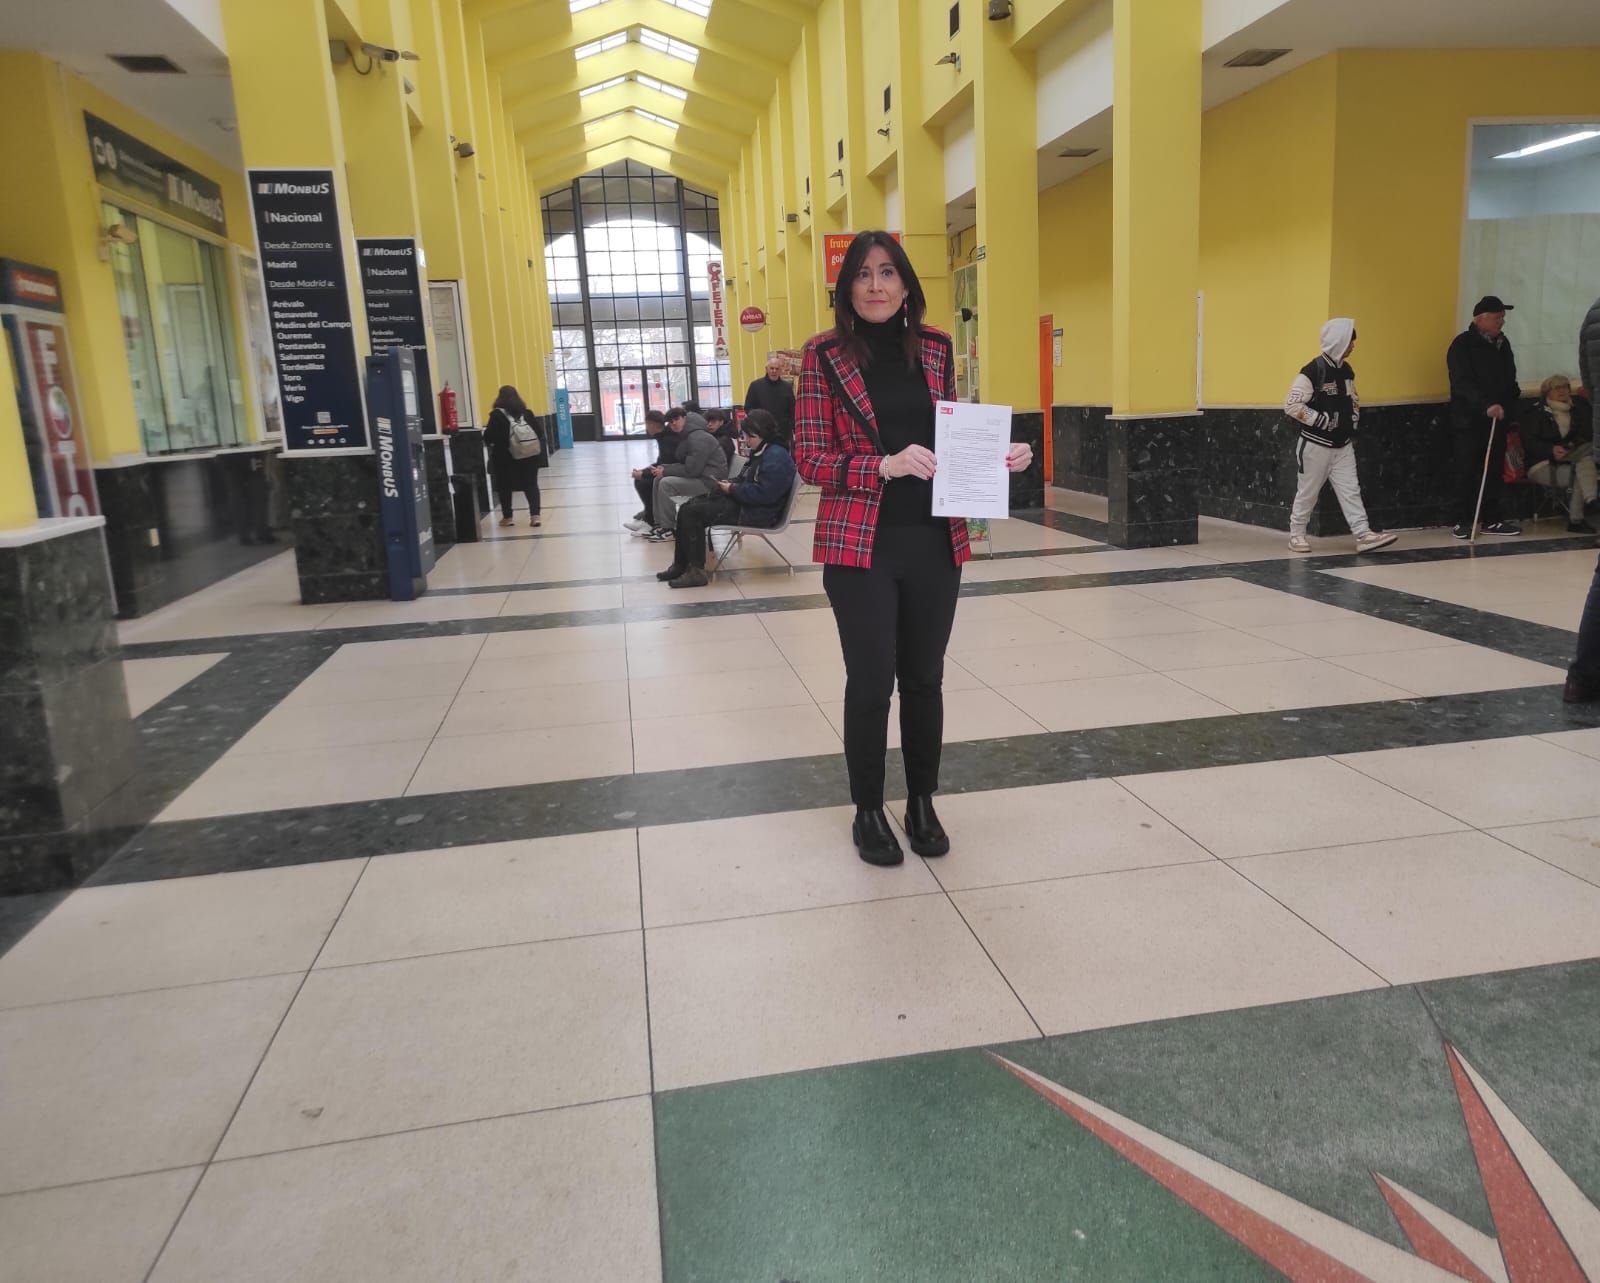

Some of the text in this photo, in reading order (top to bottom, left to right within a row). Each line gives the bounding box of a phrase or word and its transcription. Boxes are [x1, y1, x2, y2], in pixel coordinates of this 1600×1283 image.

[274, 183, 330, 194] MONBUS
[271, 212, 323, 223] Nacional
[371, 267, 408, 276] Nacional
[269, 280, 295, 288] Desde
[297, 279, 326, 287] Madrid
[707, 262, 726, 346] CAFETERIA
[275, 320, 352, 329] Medina del Campo
[279, 342, 326, 350] Pontevedra
[280, 353, 325, 361] Salamanca
[281, 363, 325, 371] Tordesillas
[285, 394, 305, 404] Vigo
[377, 435, 399, 498] MONBUS
